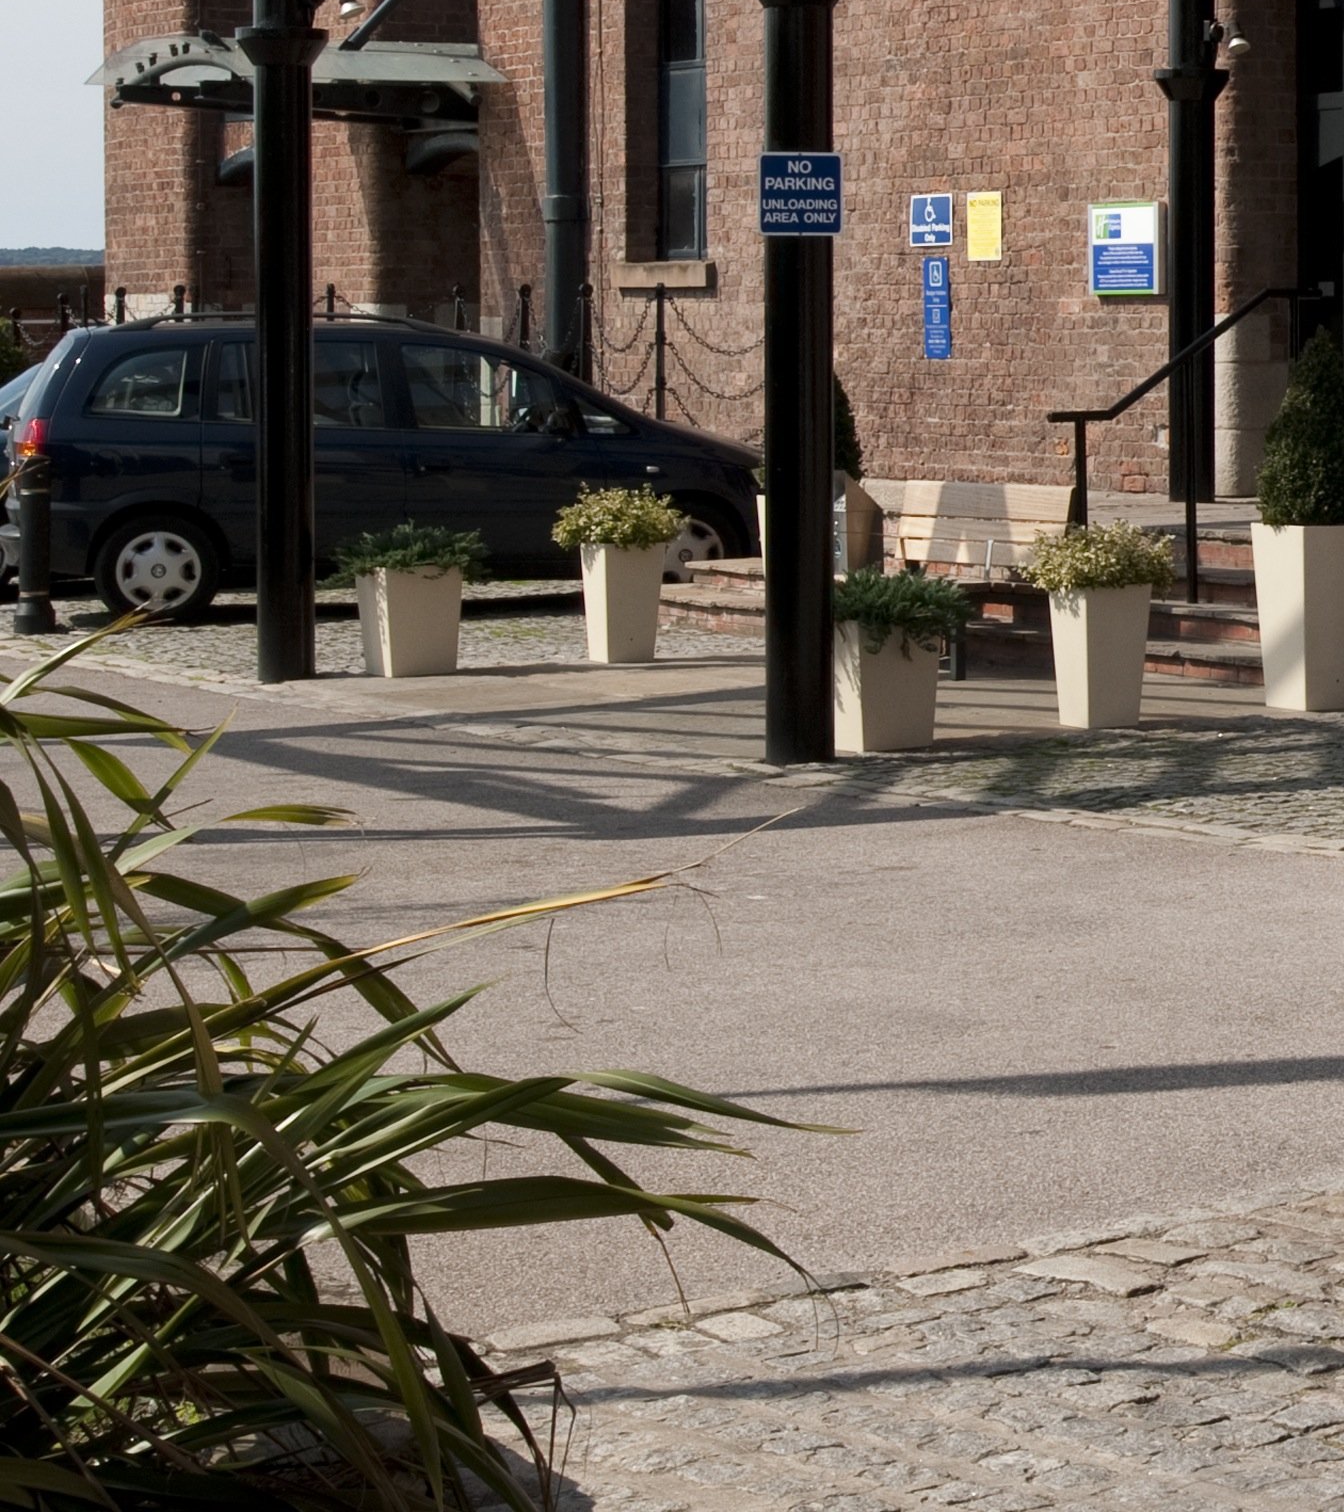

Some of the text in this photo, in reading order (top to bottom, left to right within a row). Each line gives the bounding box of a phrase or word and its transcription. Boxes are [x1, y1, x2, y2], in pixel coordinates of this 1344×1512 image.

[787, 160, 812, 174] NO
[765, 177, 835, 190] PARKING
[762, 199, 838, 210] UNLOADING
[763, 212, 837, 223] AREA ONLY
